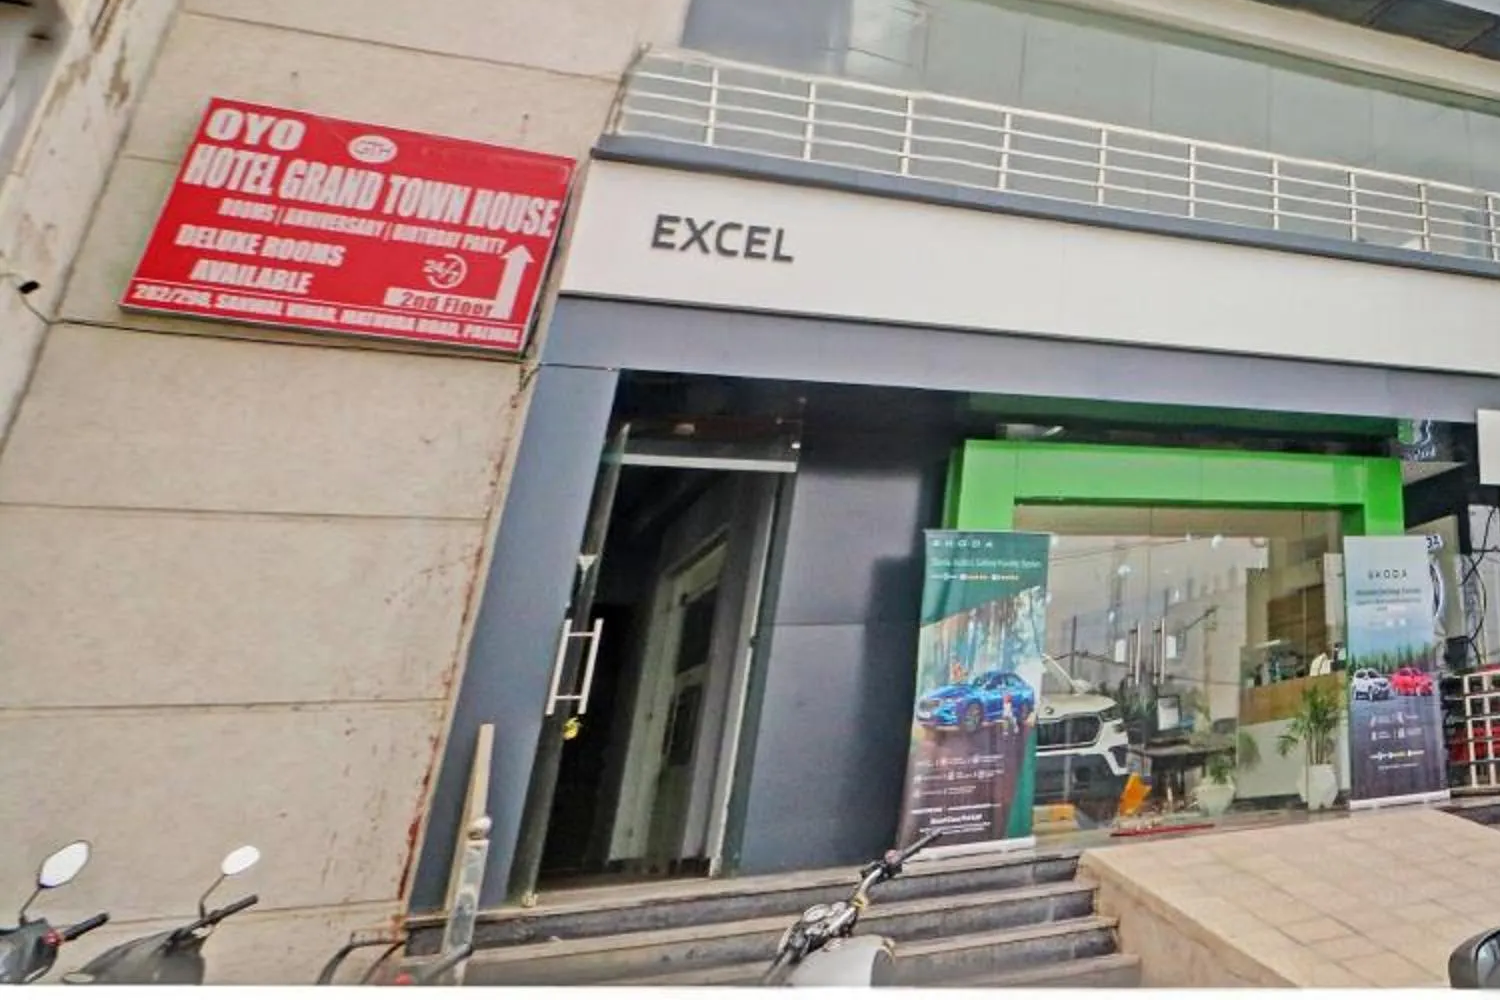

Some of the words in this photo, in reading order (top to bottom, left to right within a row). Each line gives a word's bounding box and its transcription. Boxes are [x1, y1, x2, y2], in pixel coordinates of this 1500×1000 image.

[205, 108, 306, 150] OYO
[182, 144, 281, 195] HOTEL
[278, 159, 385, 210] GRAND
[383, 174, 473, 224] TOWN
[466, 188, 560, 237] HOUSE
[174, 224, 263, 255] DELUXE
[260, 236, 347, 267] ROOMS
[651, 213, 794, 263] EXCEL
[189, 259, 315, 294] AVAILABLE
[402, 291, 438, 310] 2nd
[443, 297, 494, 317] Floor
